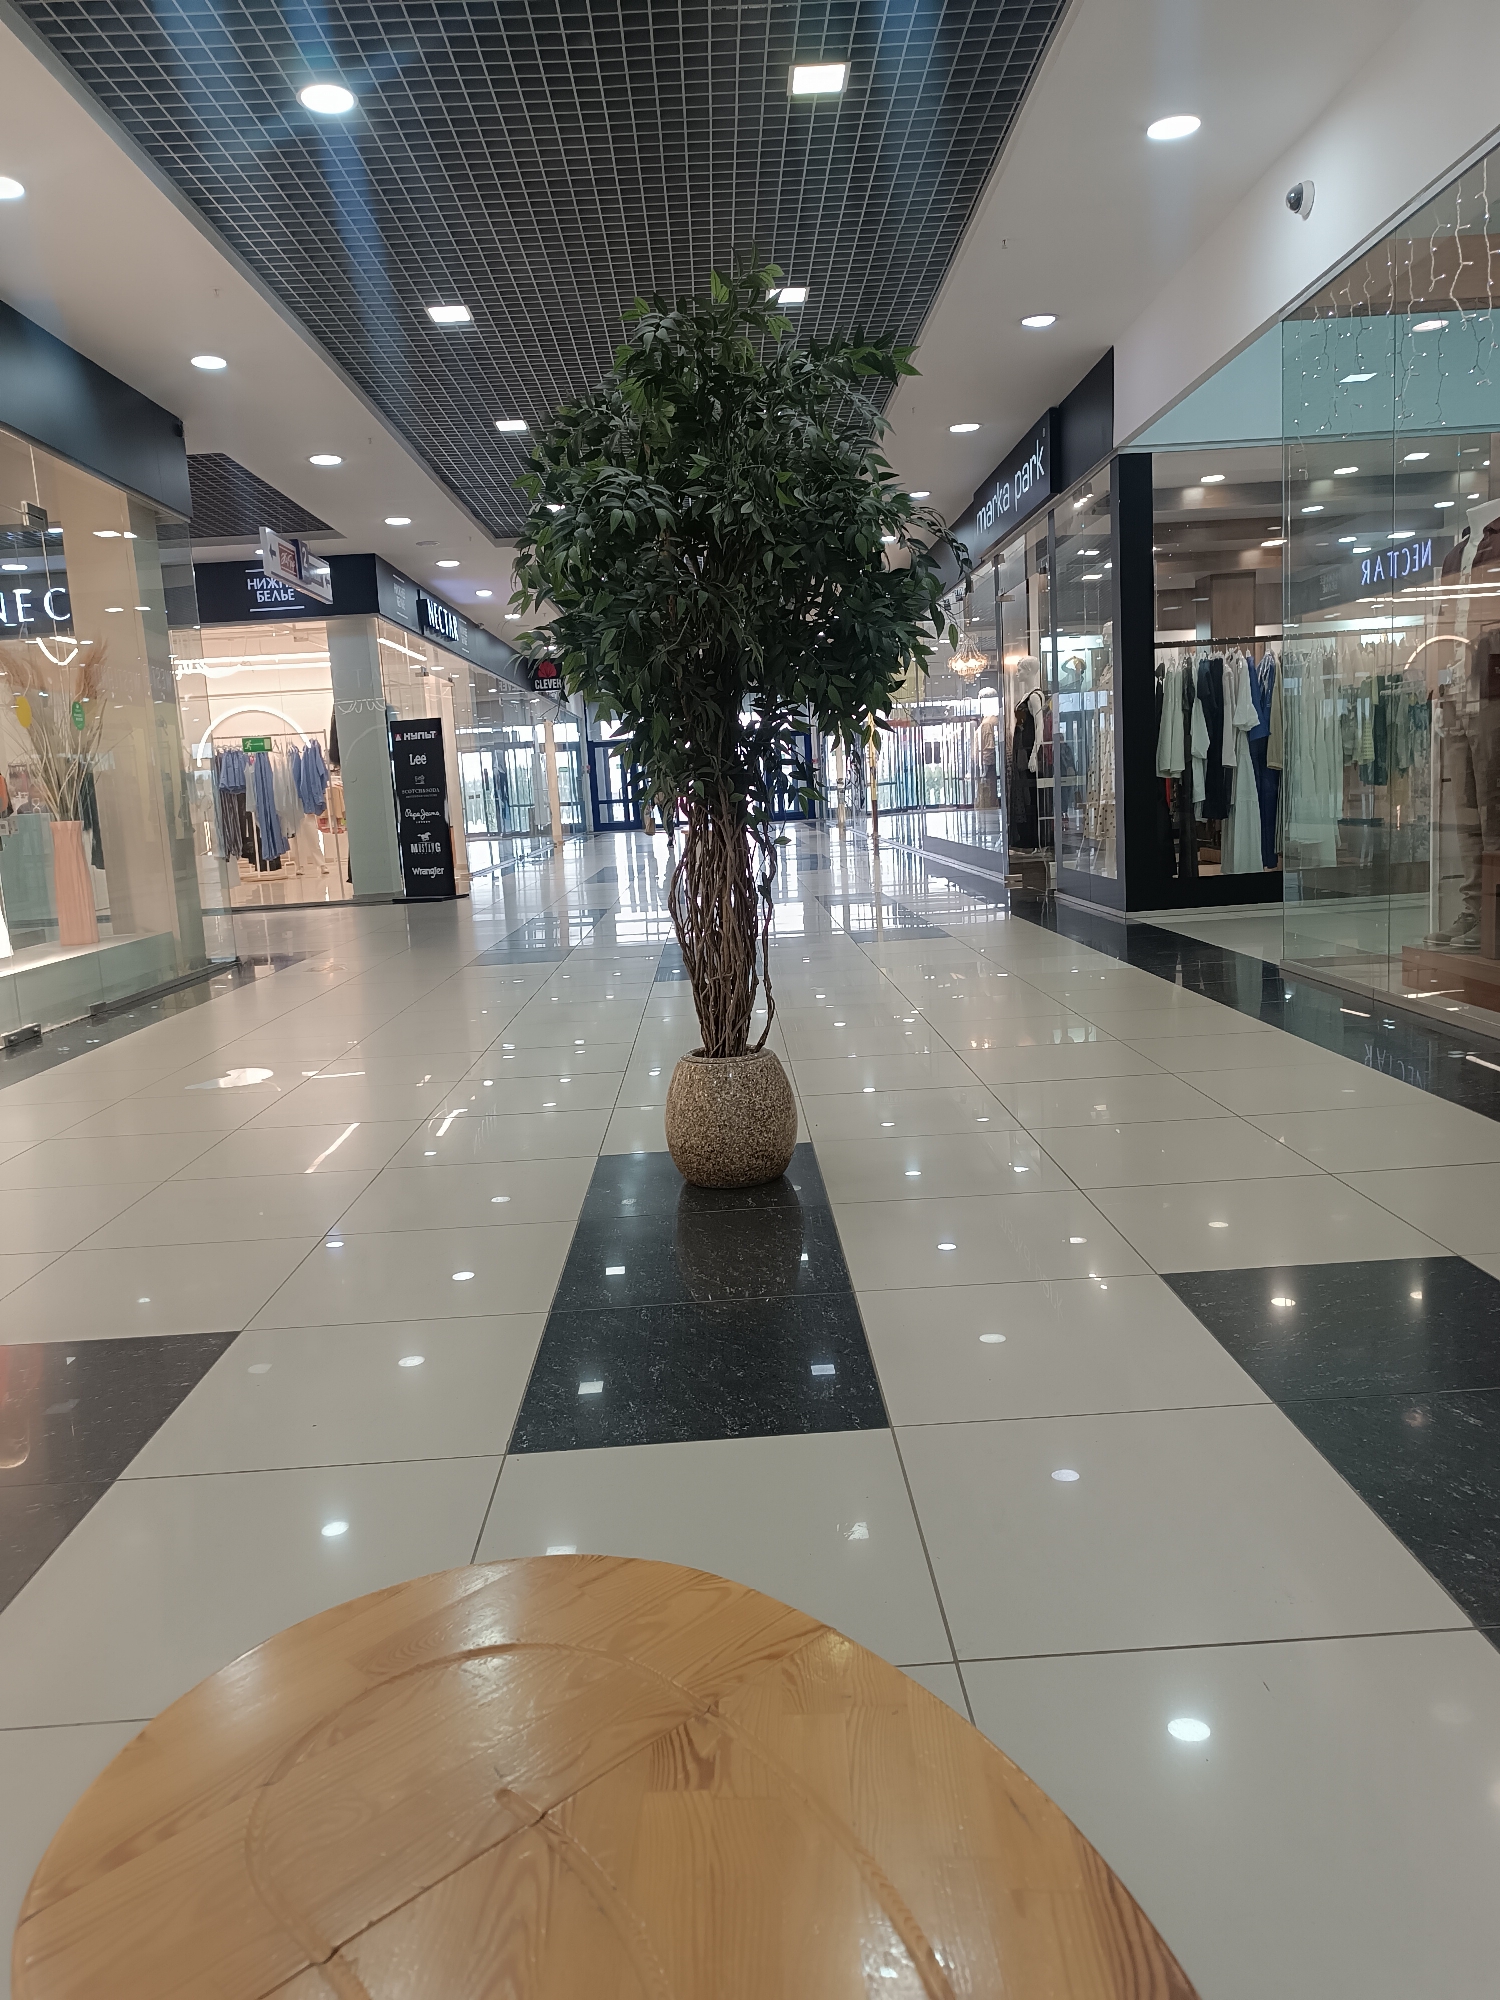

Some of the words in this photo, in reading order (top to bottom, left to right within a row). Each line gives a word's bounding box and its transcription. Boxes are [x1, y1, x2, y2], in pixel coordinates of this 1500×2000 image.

[977, 482, 1010, 536] marka
[1014, 439, 1045, 512] park
[247, 577, 293, 591] НИЖ
[256, 588, 296, 603] БЕЛЬЕ
[426, 598, 460, 641] NECTAR
[408, 753, 428, 766] Lee
[411, 866, 445, 879] Wrangler
